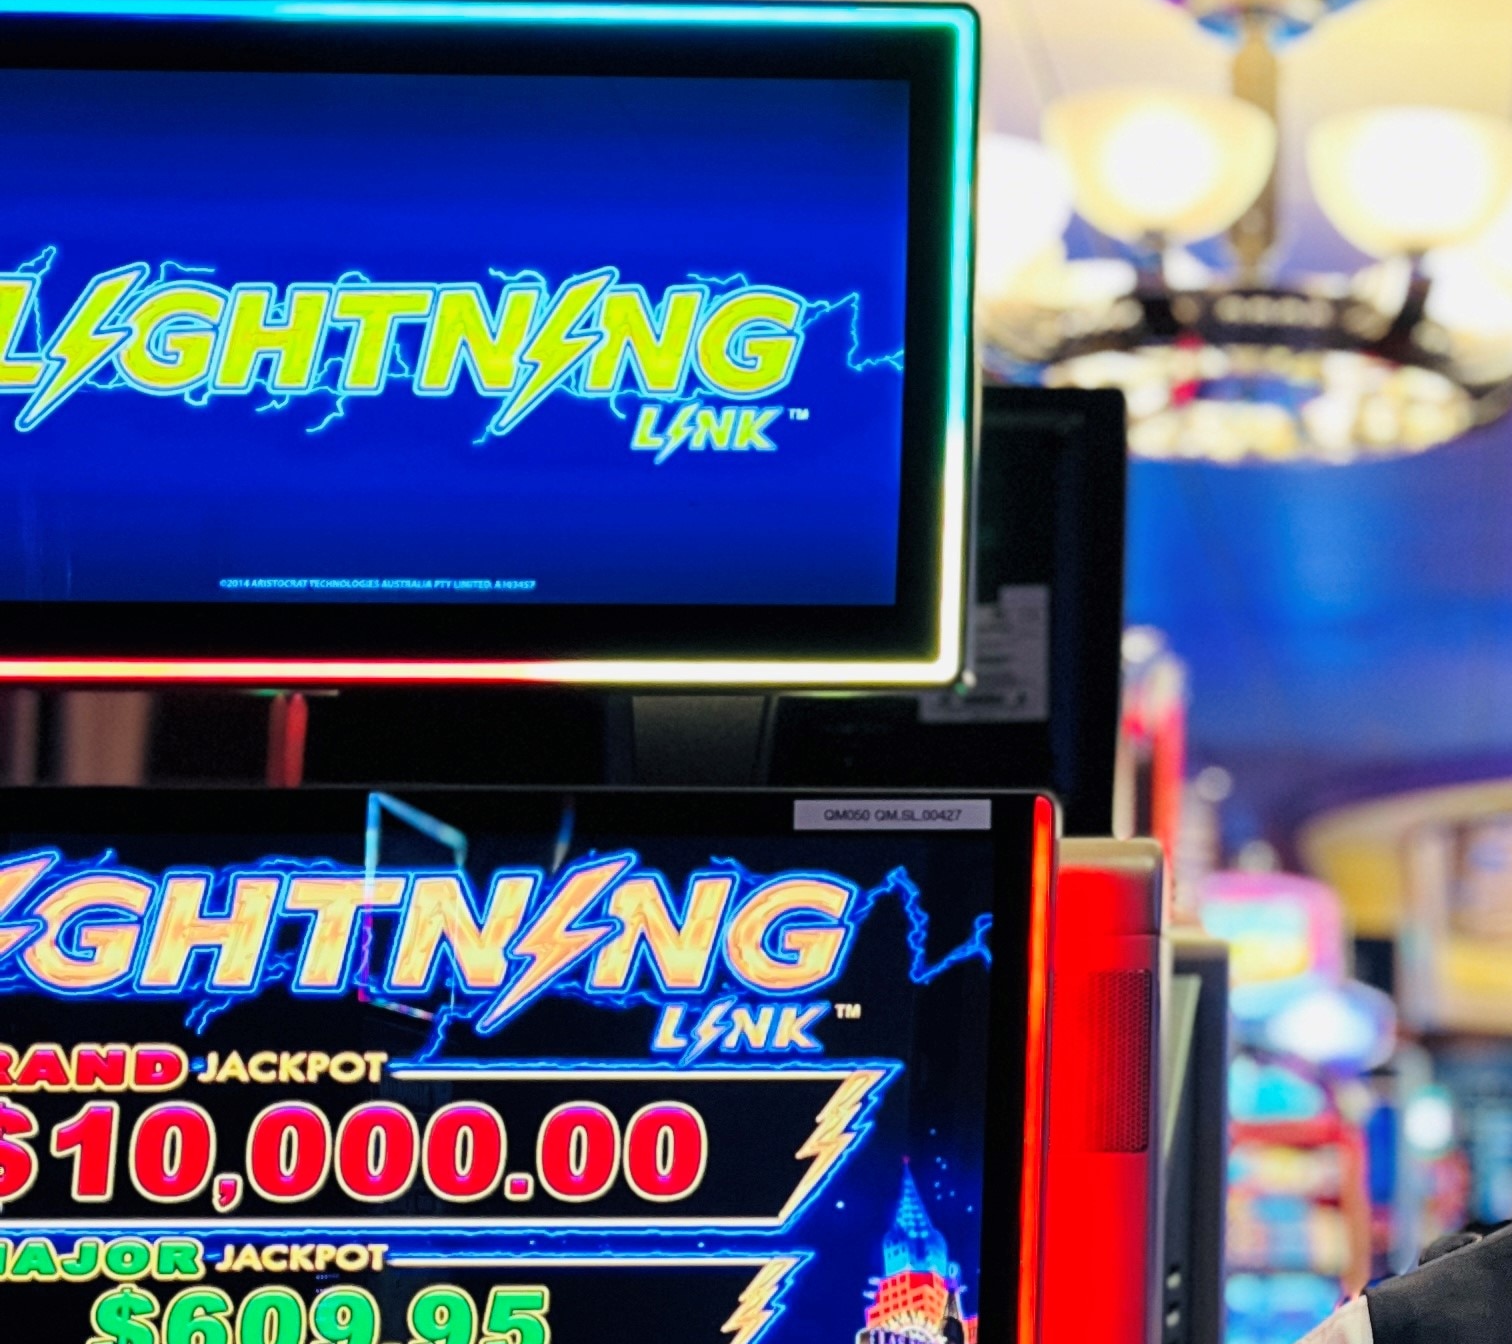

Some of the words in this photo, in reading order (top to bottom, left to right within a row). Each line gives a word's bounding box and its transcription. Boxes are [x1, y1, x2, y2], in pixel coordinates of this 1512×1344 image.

[630, 400, 785, 465] LINK
[252, 579, 307, 588] ARISTOCRAT
[309, 579, 379, 588] TECHNOLOGIES
[381, 580, 432, 588] AUSTRALIA
[434, 580, 452, 588] PTY
[651, 996, 831, 1066] LINK
[198, 1050, 388, 1083] JACKPOT
[0, 1237, 206, 1282] AJOR
[215, 1243, 388, 1272] JACKPOT
